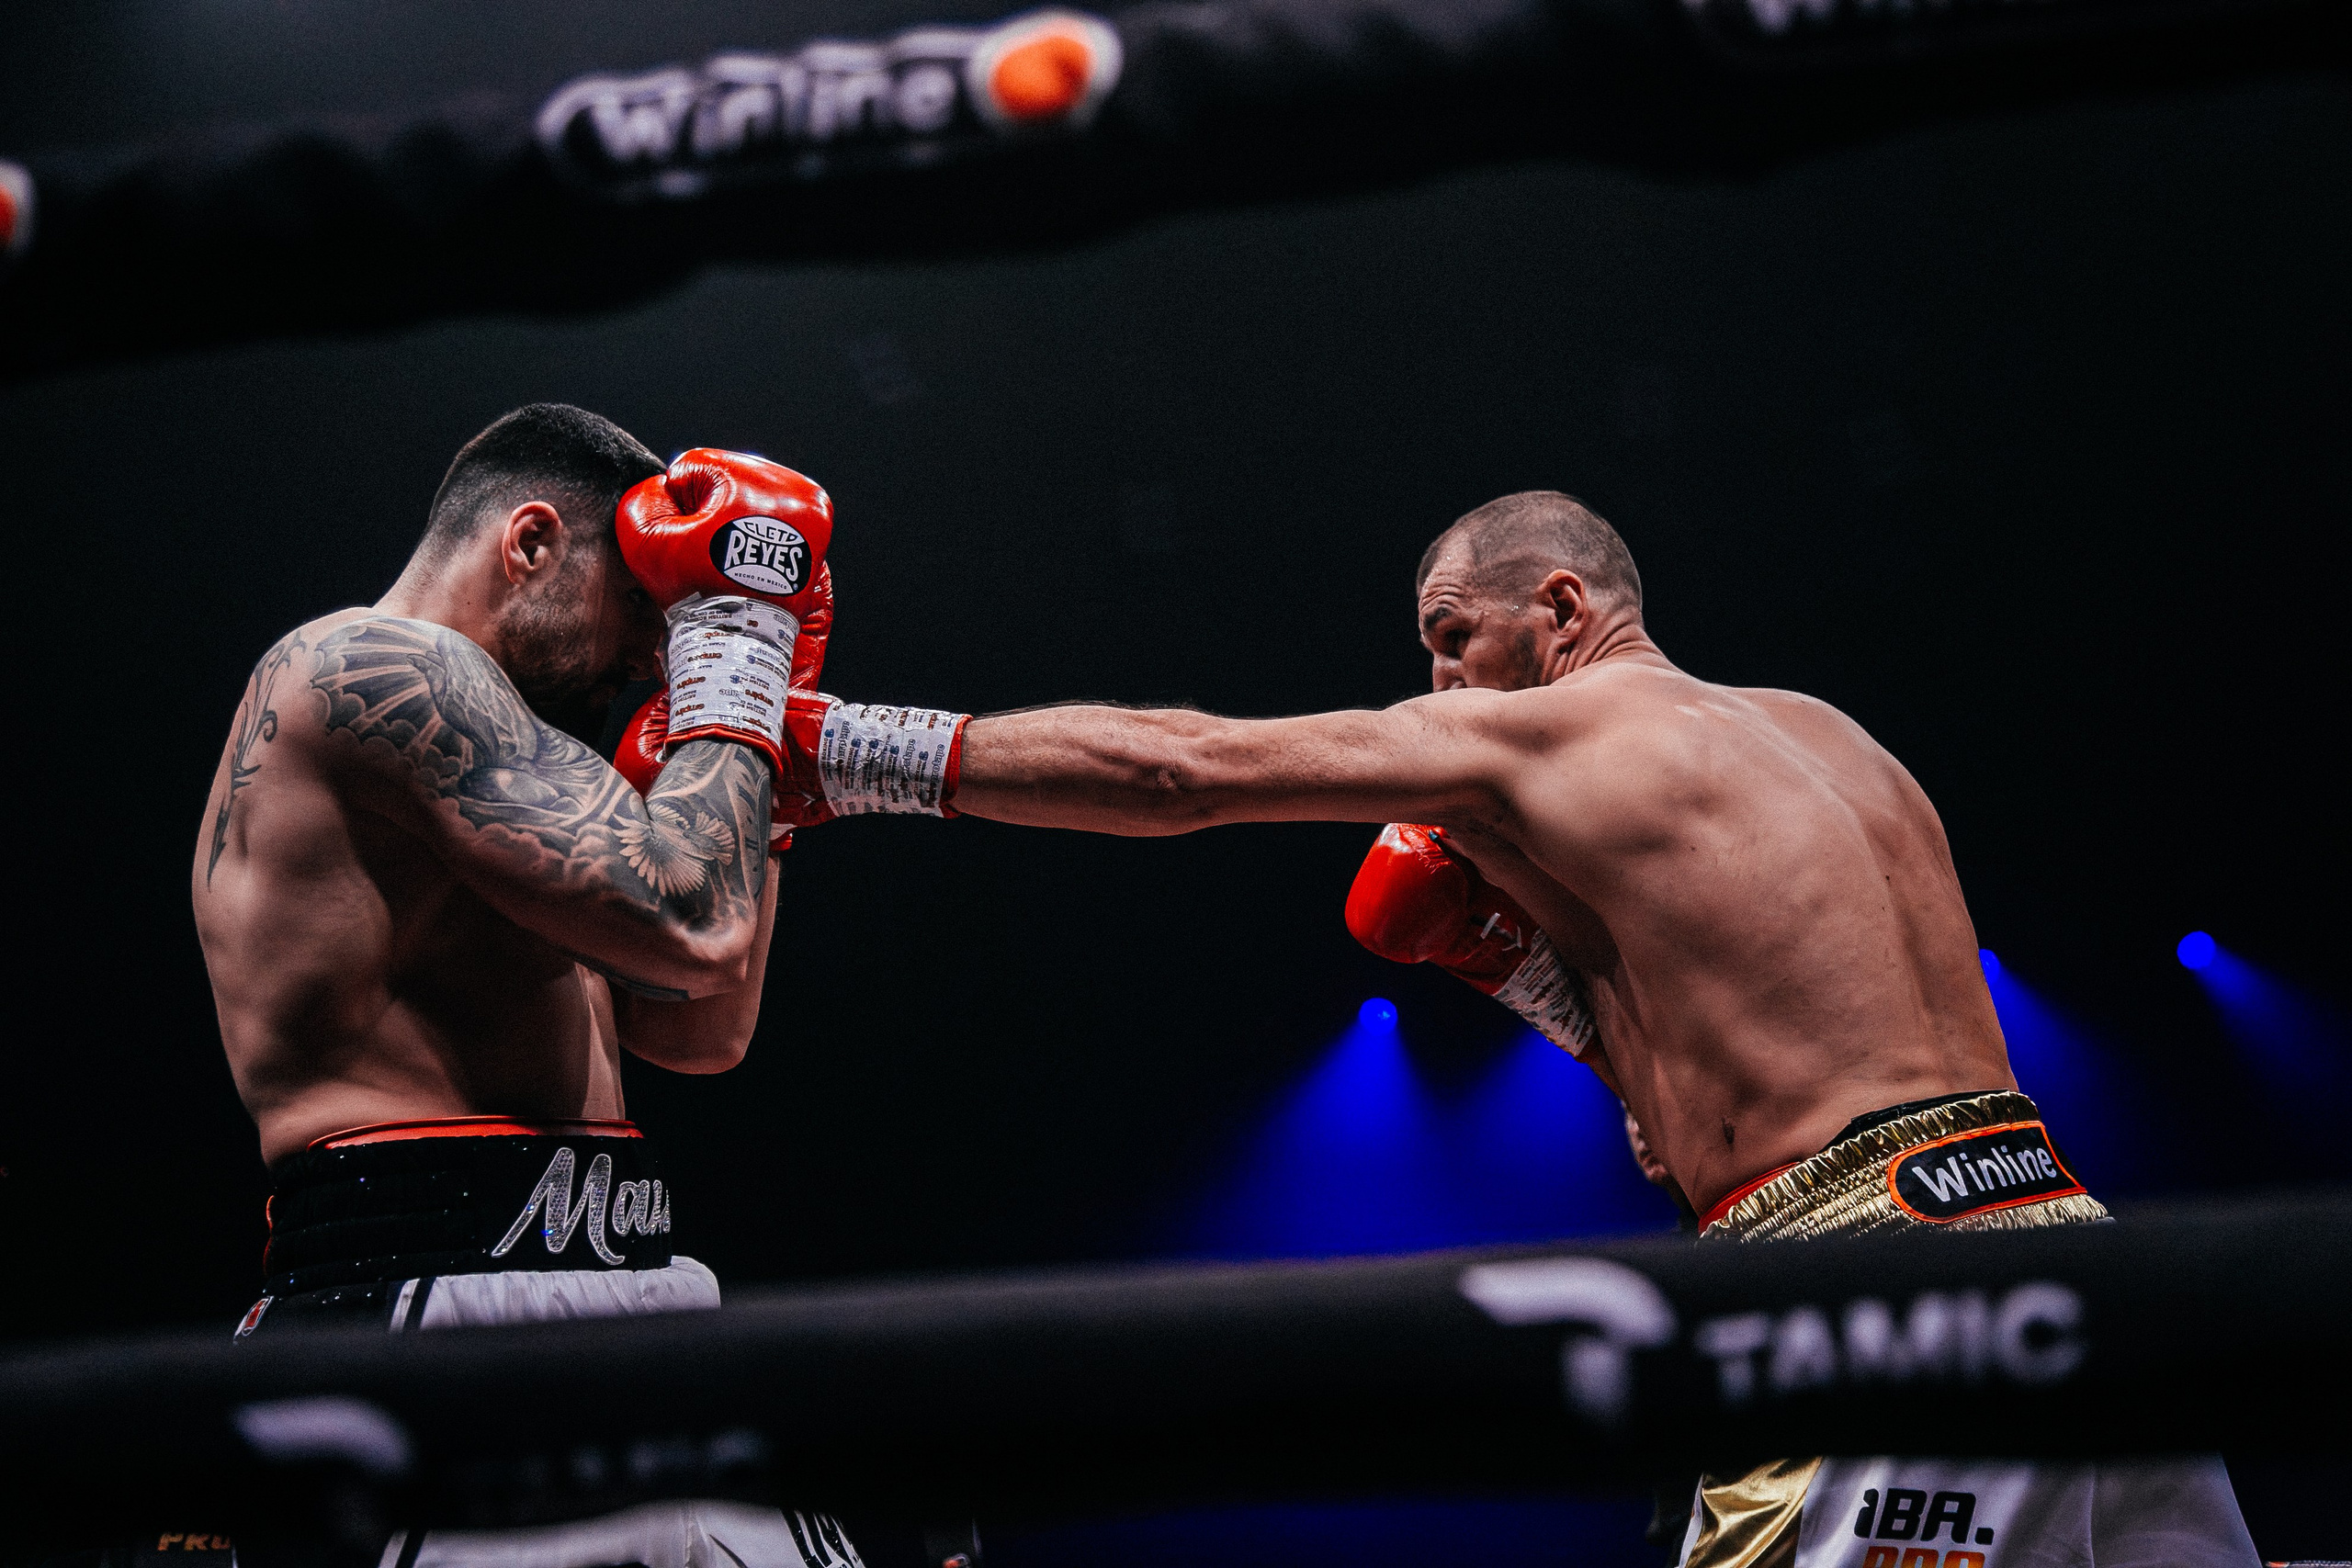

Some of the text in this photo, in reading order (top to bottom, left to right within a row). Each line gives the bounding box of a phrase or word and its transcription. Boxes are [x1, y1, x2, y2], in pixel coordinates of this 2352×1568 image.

[745, 522, 797, 542] CLETO
[724, 530, 802, 581] REYES
[734, 572, 755, 581] HECHO
[767, 580, 787, 590] MEXICO
[744, 689, 774, 707] empire
[930, 743, 945, 784] protape
[1912, 1145, 2057, 1202] Winline
[1692, 1280, 2089, 1407] TAMIC
